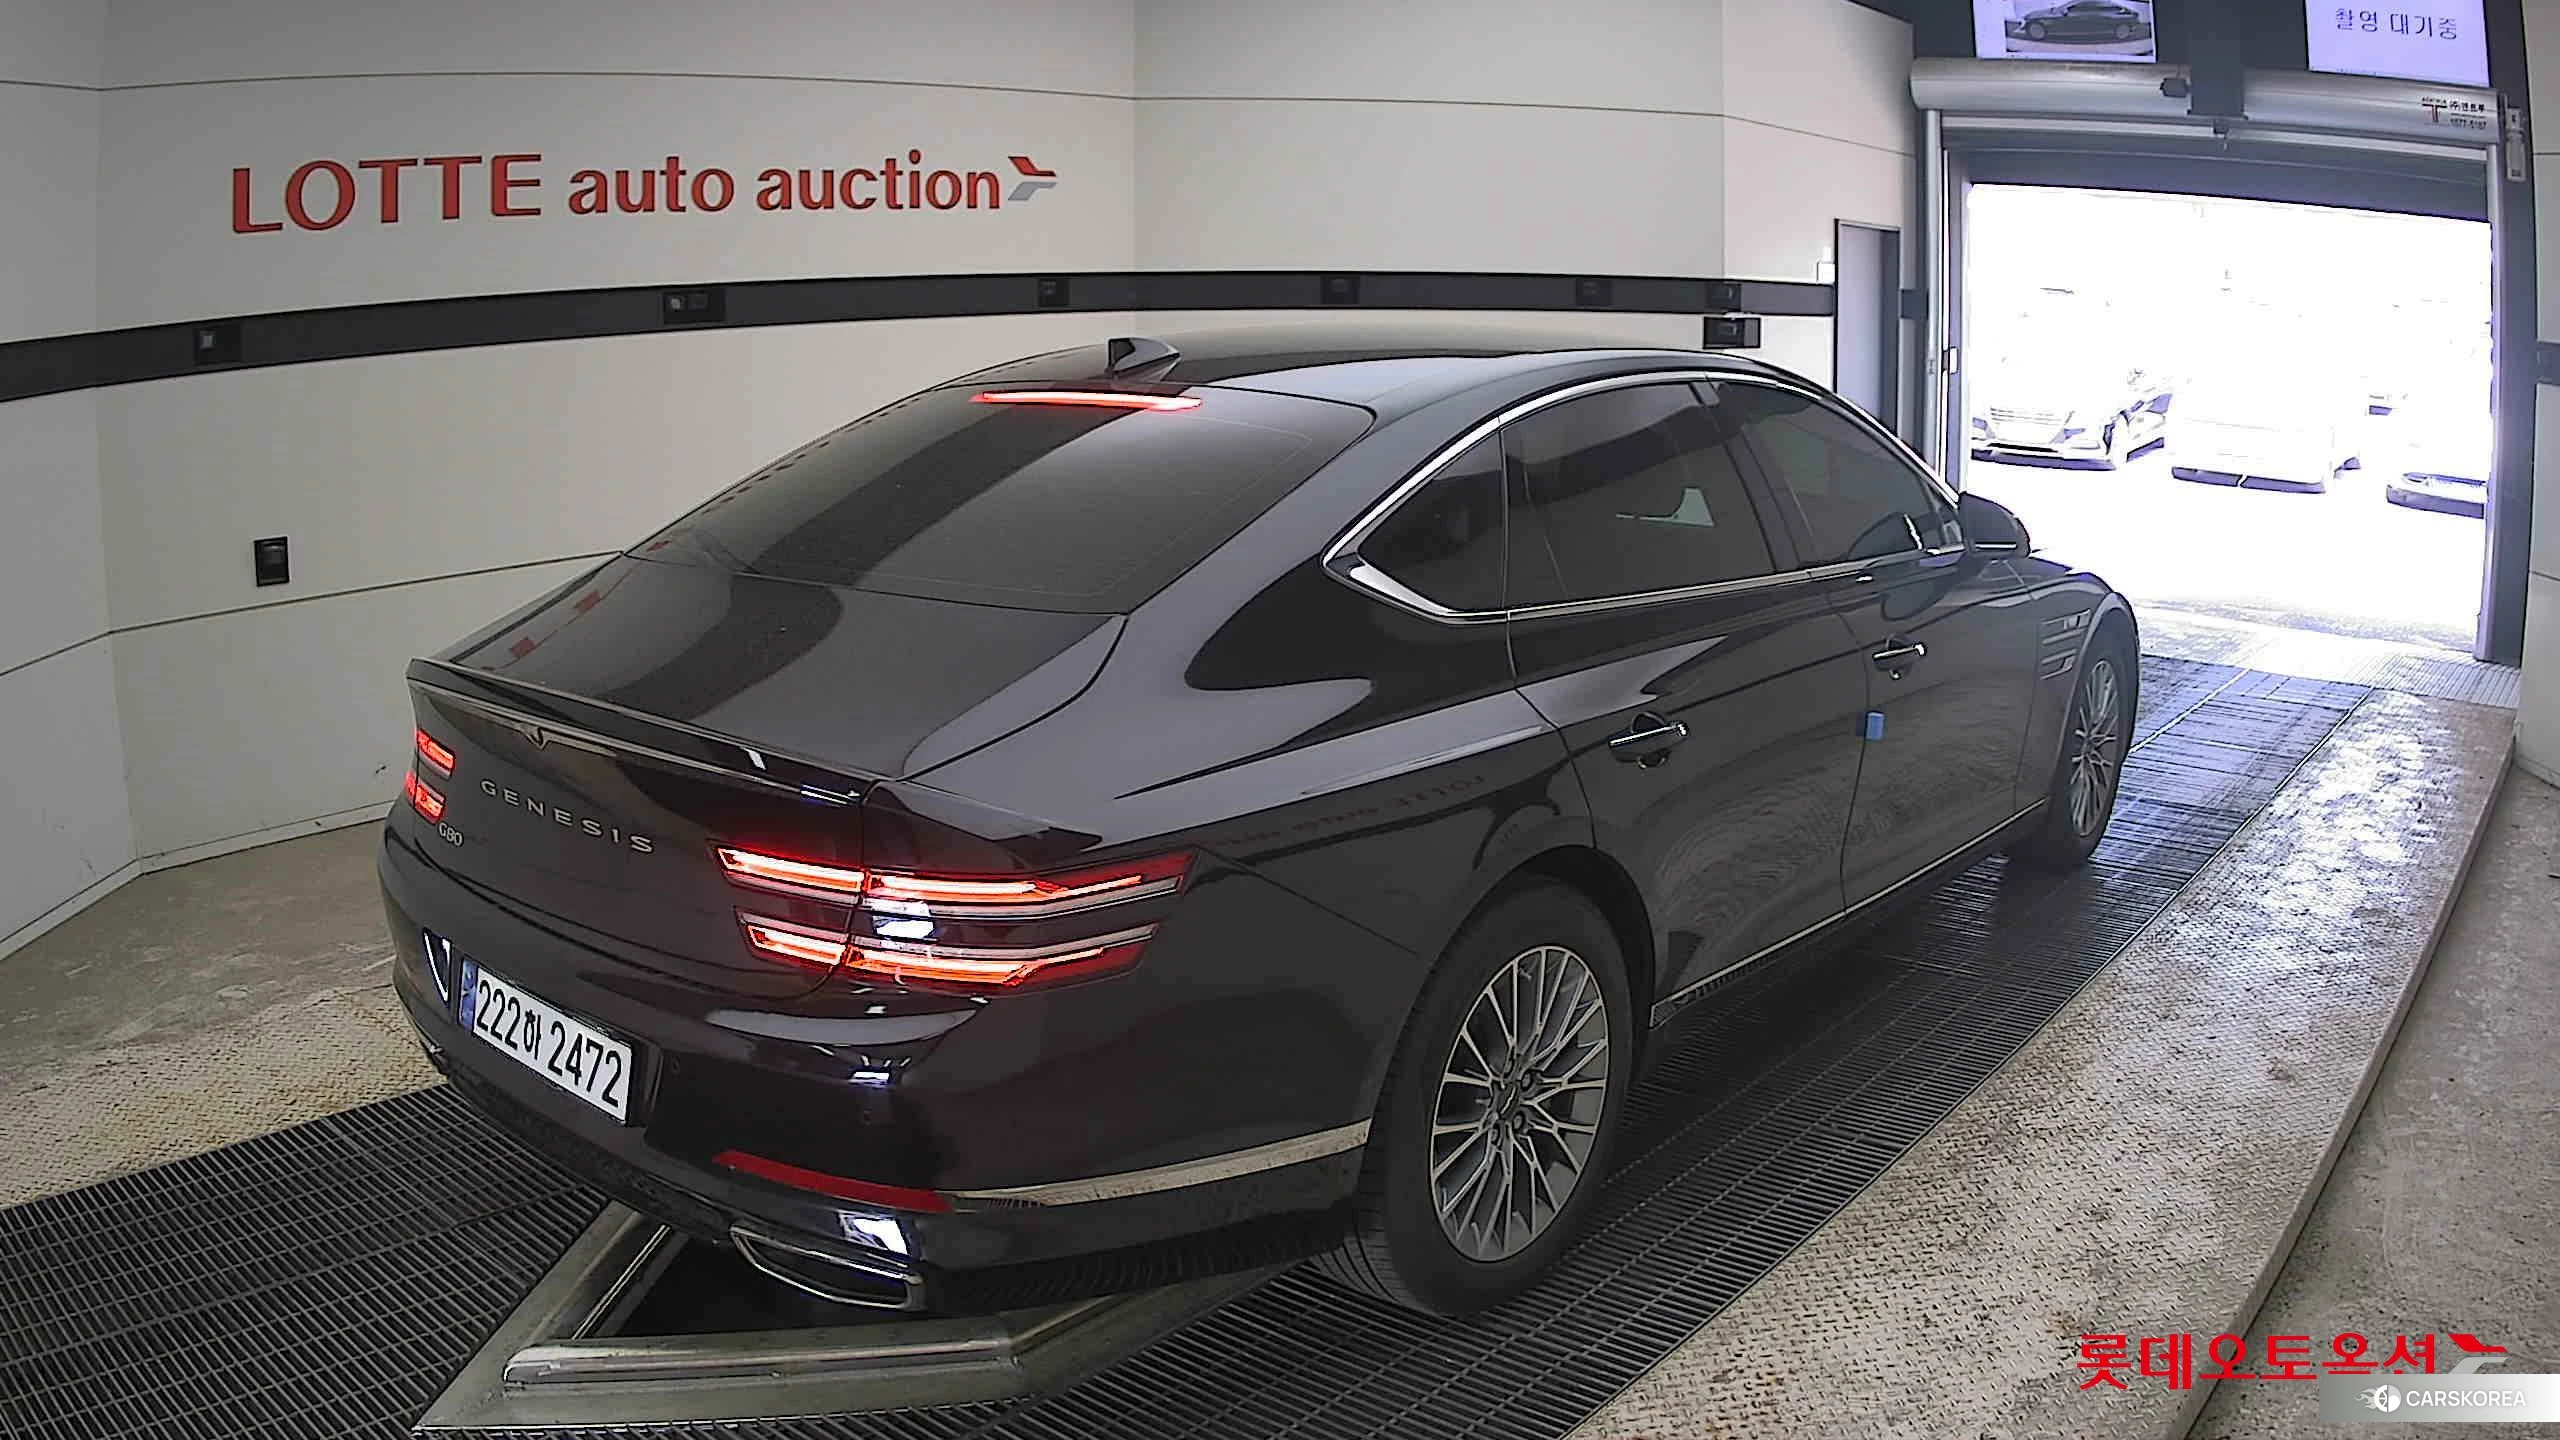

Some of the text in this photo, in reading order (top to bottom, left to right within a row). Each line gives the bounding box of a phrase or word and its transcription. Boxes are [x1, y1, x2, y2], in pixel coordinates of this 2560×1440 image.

[2335, 7, 2457, 40] 촬영 대기중
[231, 149, 1001, 234] LOTTE auto auction
[438, 821, 465, 848] G80
[479, 778, 655, 855] GENESIS
[475, 979, 624, 1108] 222하 2472
